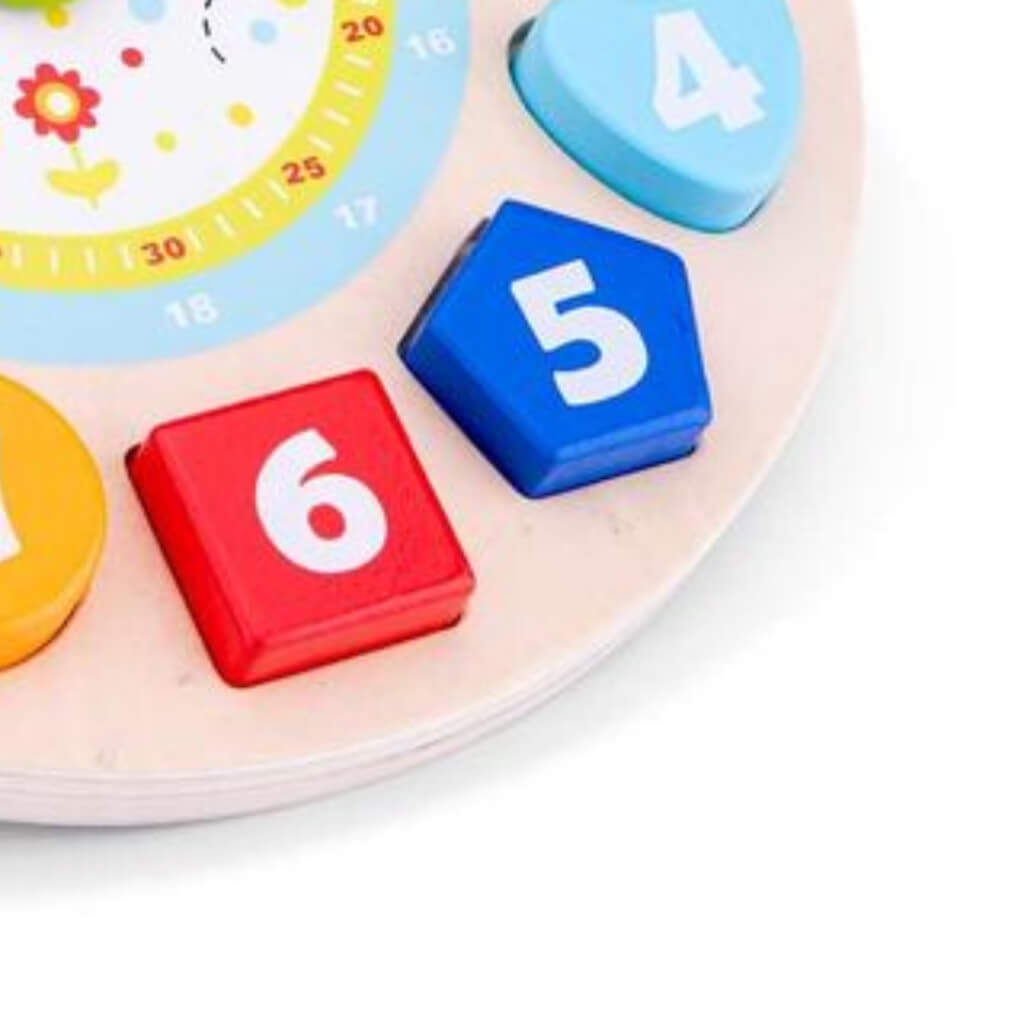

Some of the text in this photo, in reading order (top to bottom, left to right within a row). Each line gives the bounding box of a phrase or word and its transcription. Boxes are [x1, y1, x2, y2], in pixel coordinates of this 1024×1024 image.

[342, 15, 384, 43] 20
[407, 26, 456, 59] 16
[654, 11, 762, 128] 4
[281, 155, 326, 185] 25
[333, 196, 376, 230] 17
[140, 236, 186, 265] 30
[164, 292, 217, 328] 18
[513, 261, 646, 403] 5
[256, 430, 386, 572] 6
